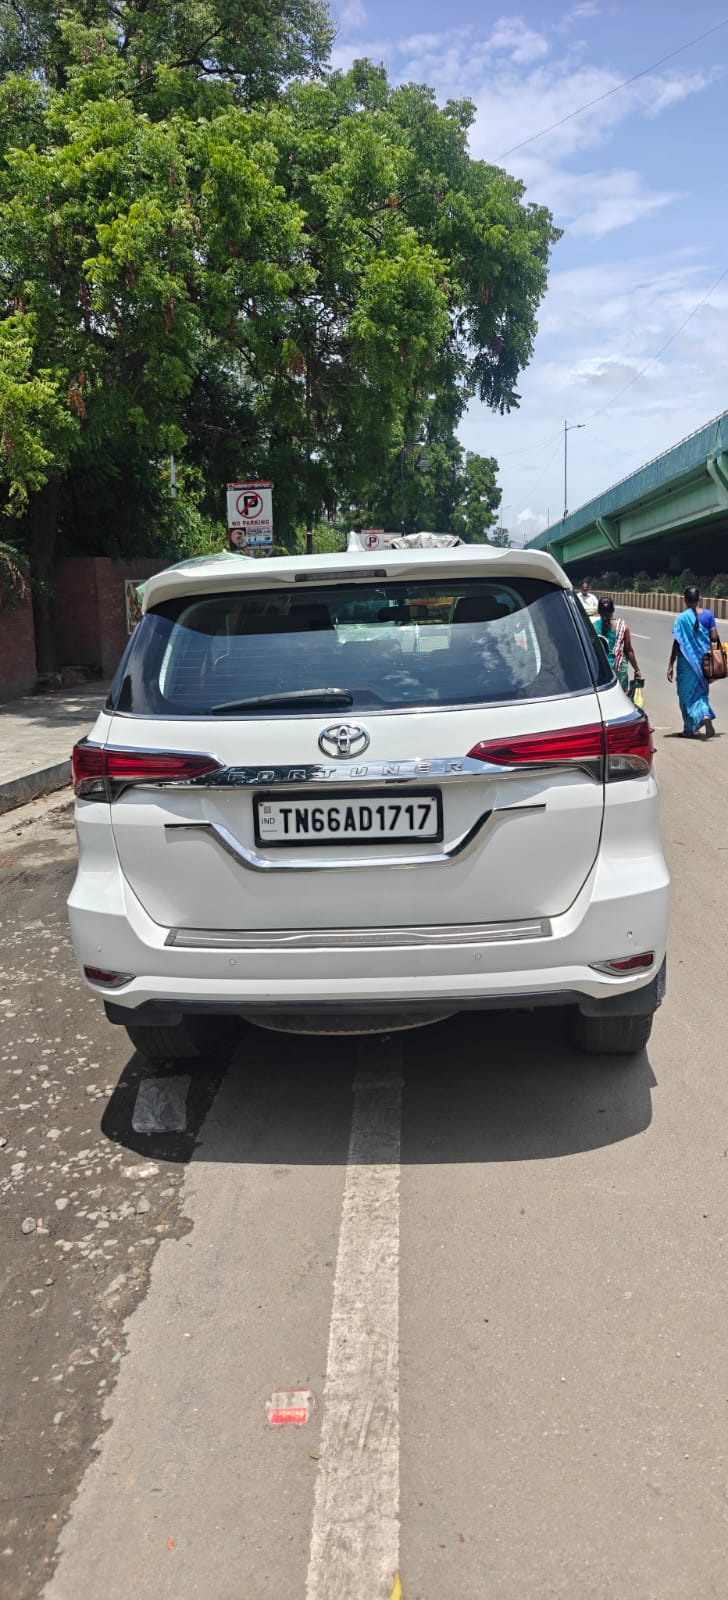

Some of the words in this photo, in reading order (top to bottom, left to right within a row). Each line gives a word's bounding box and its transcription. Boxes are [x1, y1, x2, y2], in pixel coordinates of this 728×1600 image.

[227, 762, 464, 782] FORTUNER
[261, 817, 275, 825] IND
[279, 804, 431, 834] TN66AD1717
